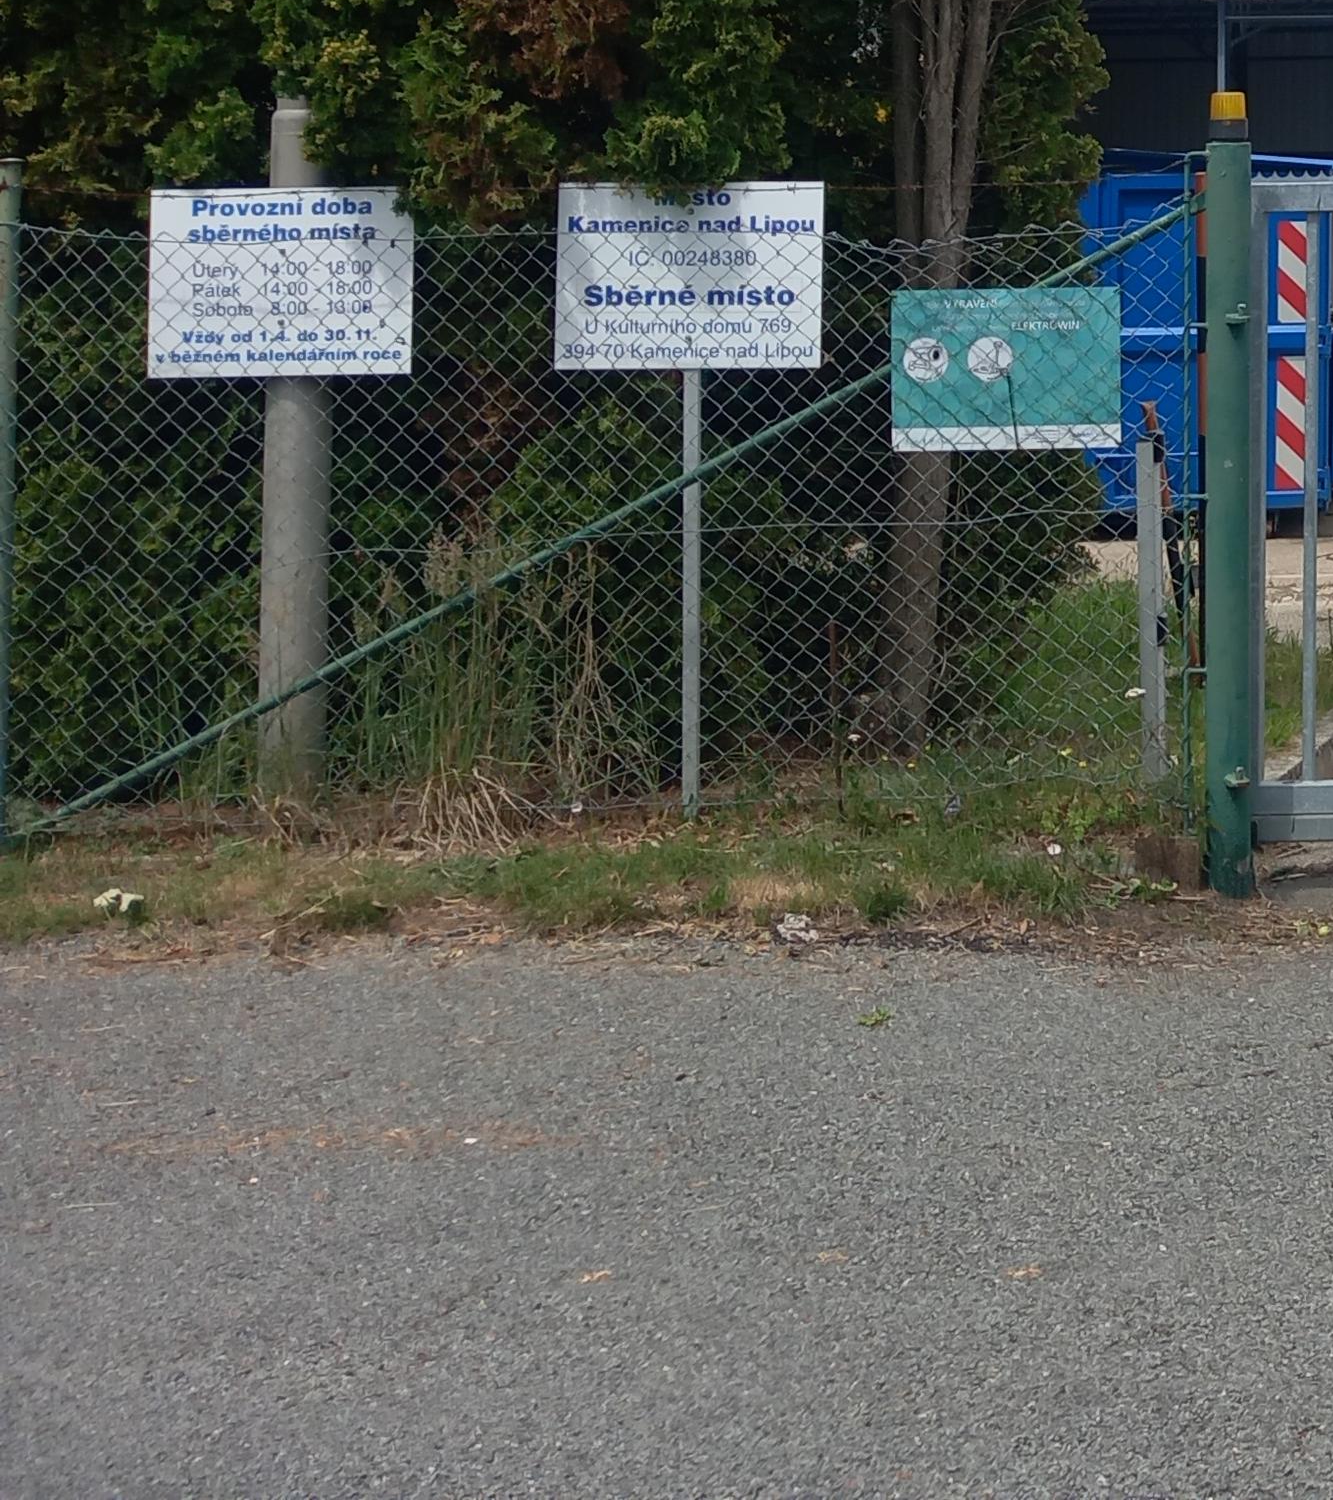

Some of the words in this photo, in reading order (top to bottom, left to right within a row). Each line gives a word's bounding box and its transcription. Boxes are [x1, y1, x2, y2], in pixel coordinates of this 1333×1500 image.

[191, 198, 303, 217] Provozní
[311, 197, 373, 216] doba
[654, 190, 731, 206] Msto
[188, 223, 302, 243] sběrného
[310, 222, 376, 241] místa
[568, 215, 690, 234] Kamenice
[698, 215, 741, 233] nad
[750, 215, 815, 236] Lipou
[661, 249, 757, 267] 00248380
[261, 262, 308, 276] 14:00
[328, 260, 373, 275] 18:00
[193, 282, 242, 298] Pátek
[262, 281, 308, 297] 14:00
[328, 280, 373, 296] 18:00
[583, 284, 696, 307] Sběrné
[707, 284, 796, 306] místo
[193, 302, 253, 318] Sobota
[270, 302, 308, 316] 8:00
[328, 300, 373, 315] 13:00
[585, 319, 599, 335] U
[605, 318, 697, 334] Kulturního
[702, 318, 752, 334] domu
[760, 317, 792, 333] 769
[182, 330, 224, 346] Vždy
[231, 330, 251, 343] od
[297, 329, 318, 342] do
[155, 353, 166, 364] v
[171, 349, 240, 363] běžném
[246, 348, 358, 362] kalendářním
[363, 348, 403, 361] roce
[563, 344, 595, 360] 394
[603, 343, 626, 359] 70
[631, 343, 720, 359] Kamenice
[725, 342, 759, 359] nad
[765, 342, 814, 361] Lipou
